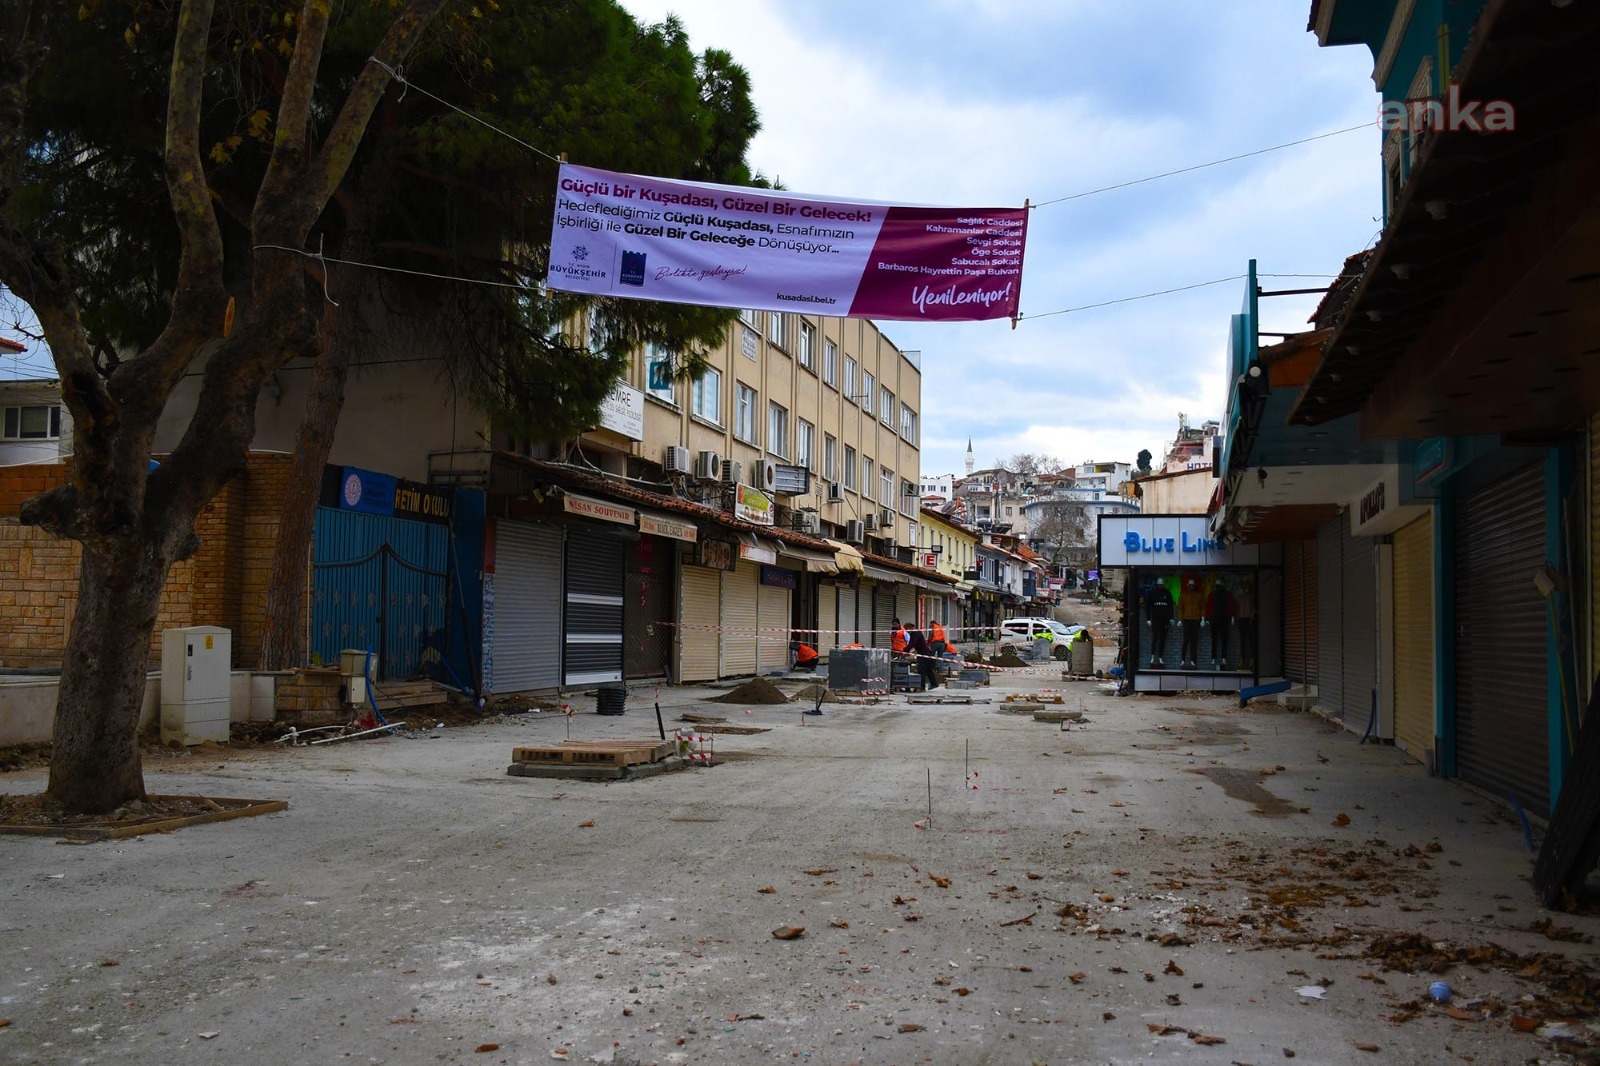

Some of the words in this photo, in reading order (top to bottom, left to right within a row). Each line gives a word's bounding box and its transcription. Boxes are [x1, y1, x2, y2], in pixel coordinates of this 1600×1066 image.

[561, 178, 609, 197] Güçlü
[613, 184, 636, 199] bir
[640, 188, 718, 211] Kuşadası,
[722, 198, 768, 214] Güzel
[772, 202, 796, 216] Bir
[800, 205, 872, 222] Gelecek!
[559, 198, 660, 220] Hedeflediğimiz
[663, 211, 703, 227] Güçlü
[707, 216, 774, 234] Kuşadası,
[777, 223, 854, 239] Esnafımızın
[957, 217, 985, 225] Sağlık
[986, 218, 1023, 227] Caddesi
[557, 212, 604, 232] İşbirliği
[606, 220, 621, 232] ile
[624, 223, 663, 238] Güzel
[666, 227, 687, 239] Bir
[689, 230, 755, 247] Geleceğe
[759, 237, 839, 254] Dönüşüyor...
[926, 224, 984, 235] Kahramanlar
[986, 228, 1022, 237] Caddesi
[966, 237, 991, 246] Sevgi
[971, 247, 991, 256] Öge
[951, 257, 990, 266] Sabucalı
[991, 258, 1020, 266] Sokak
[550, 265, 606, 278] BÜYÜKŞEHİR
[878, 262, 919, 273] Barbaros
[920, 266, 962, 276] Hayrettin
[964, 268, 985, 276] Paşa
[776, 292, 837, 304] kusadasi.bel.tr
[912, 281, 1012, 313] Yenileniyor!
[1187, 462, 1212, 471] HOT
[594, 505, 630, 521] SOUVENIR
[1124, 532, 1175, 552] BLUE
[926, 555, 935, 566] E
